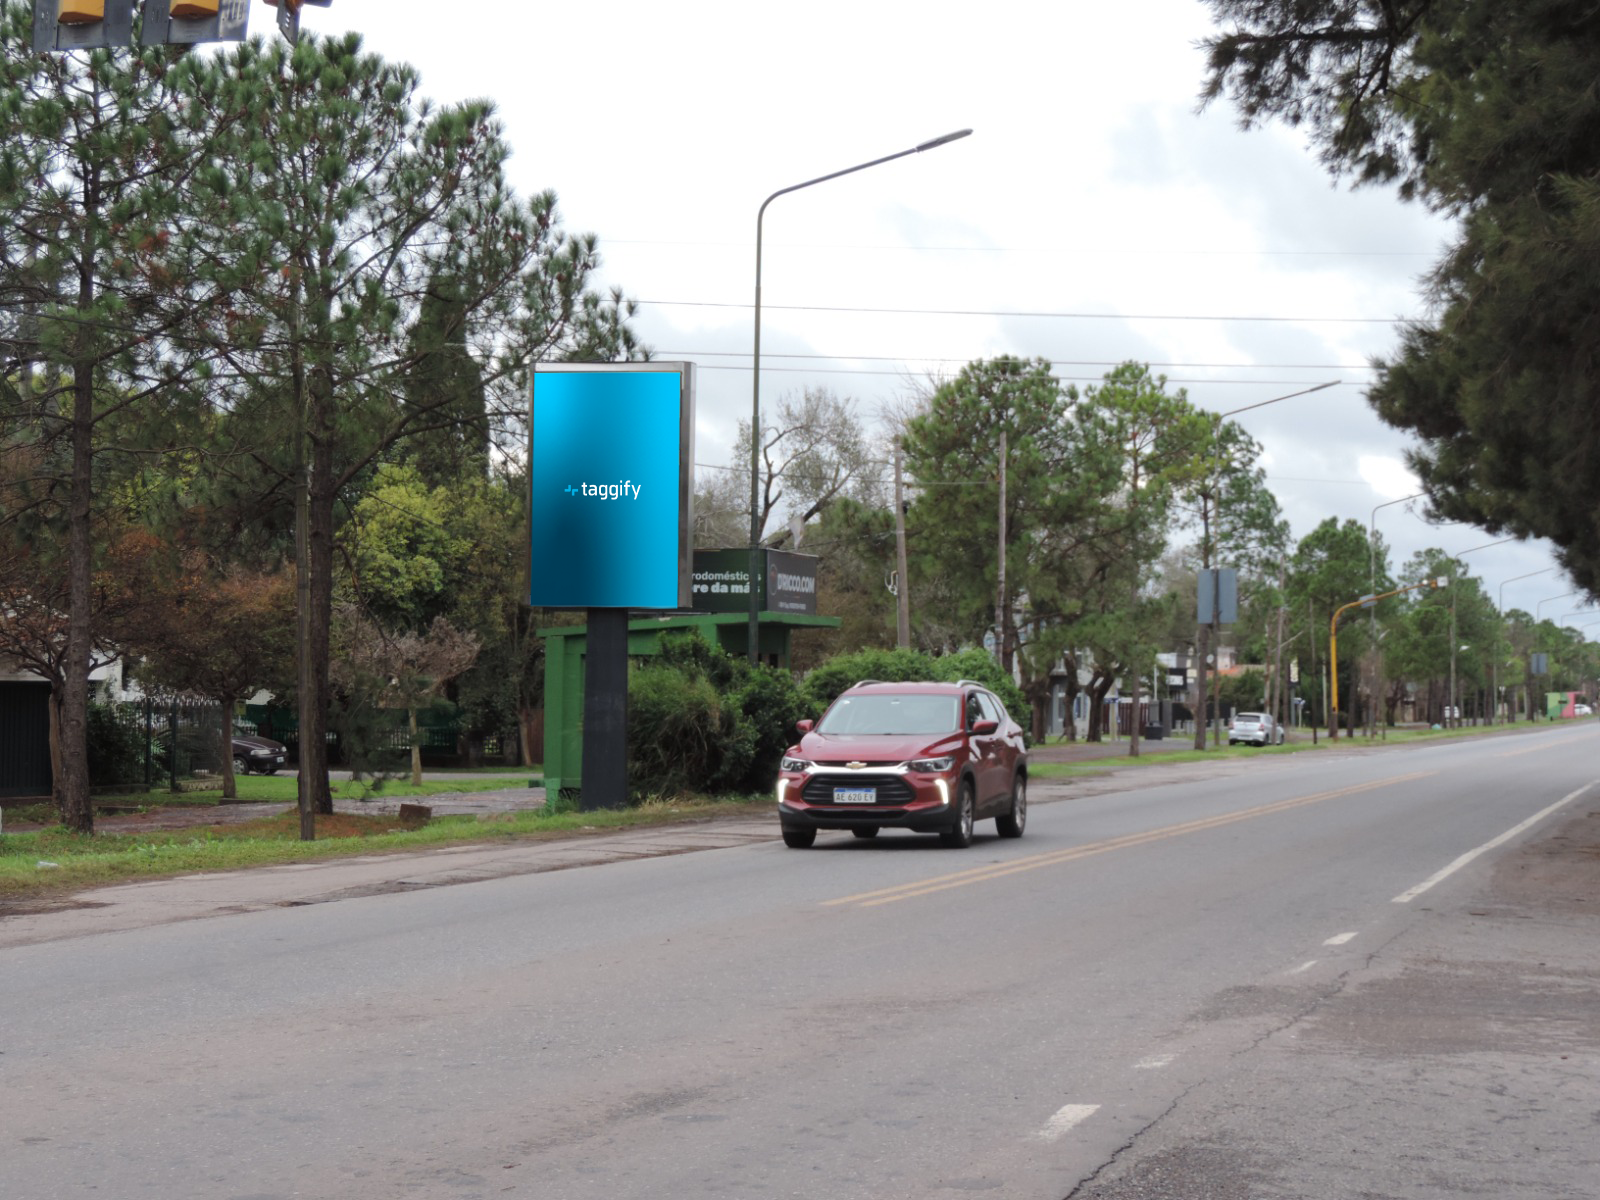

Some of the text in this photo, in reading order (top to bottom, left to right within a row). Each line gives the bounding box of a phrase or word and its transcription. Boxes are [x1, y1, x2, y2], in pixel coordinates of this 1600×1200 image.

[581, 480, 641, 500] taggify
[692, 571, 761, 581] rodoméstics
[710, 582, 729, 593] da
[836, 793, 846, 801] AE
[847, 793, 862, 801] 620
